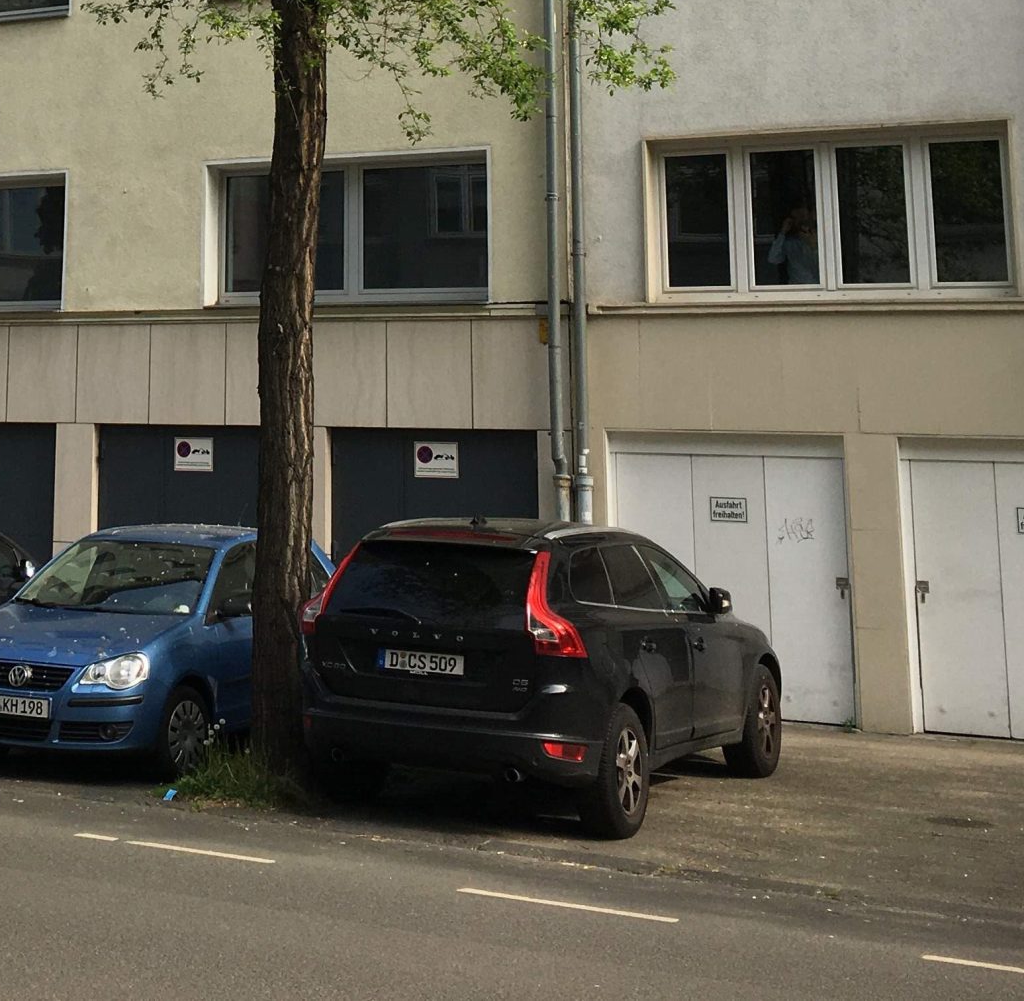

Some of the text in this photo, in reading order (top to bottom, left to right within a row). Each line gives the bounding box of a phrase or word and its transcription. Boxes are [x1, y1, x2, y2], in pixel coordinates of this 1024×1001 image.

[715, 500, 742, 509] Ausfahrt
[713, 511, 745, 519] freihalten!
[369, 628, 464, 642] VOLVO
[429, 656, 457, 673] 509
[20, 701, 43, 716] 198
